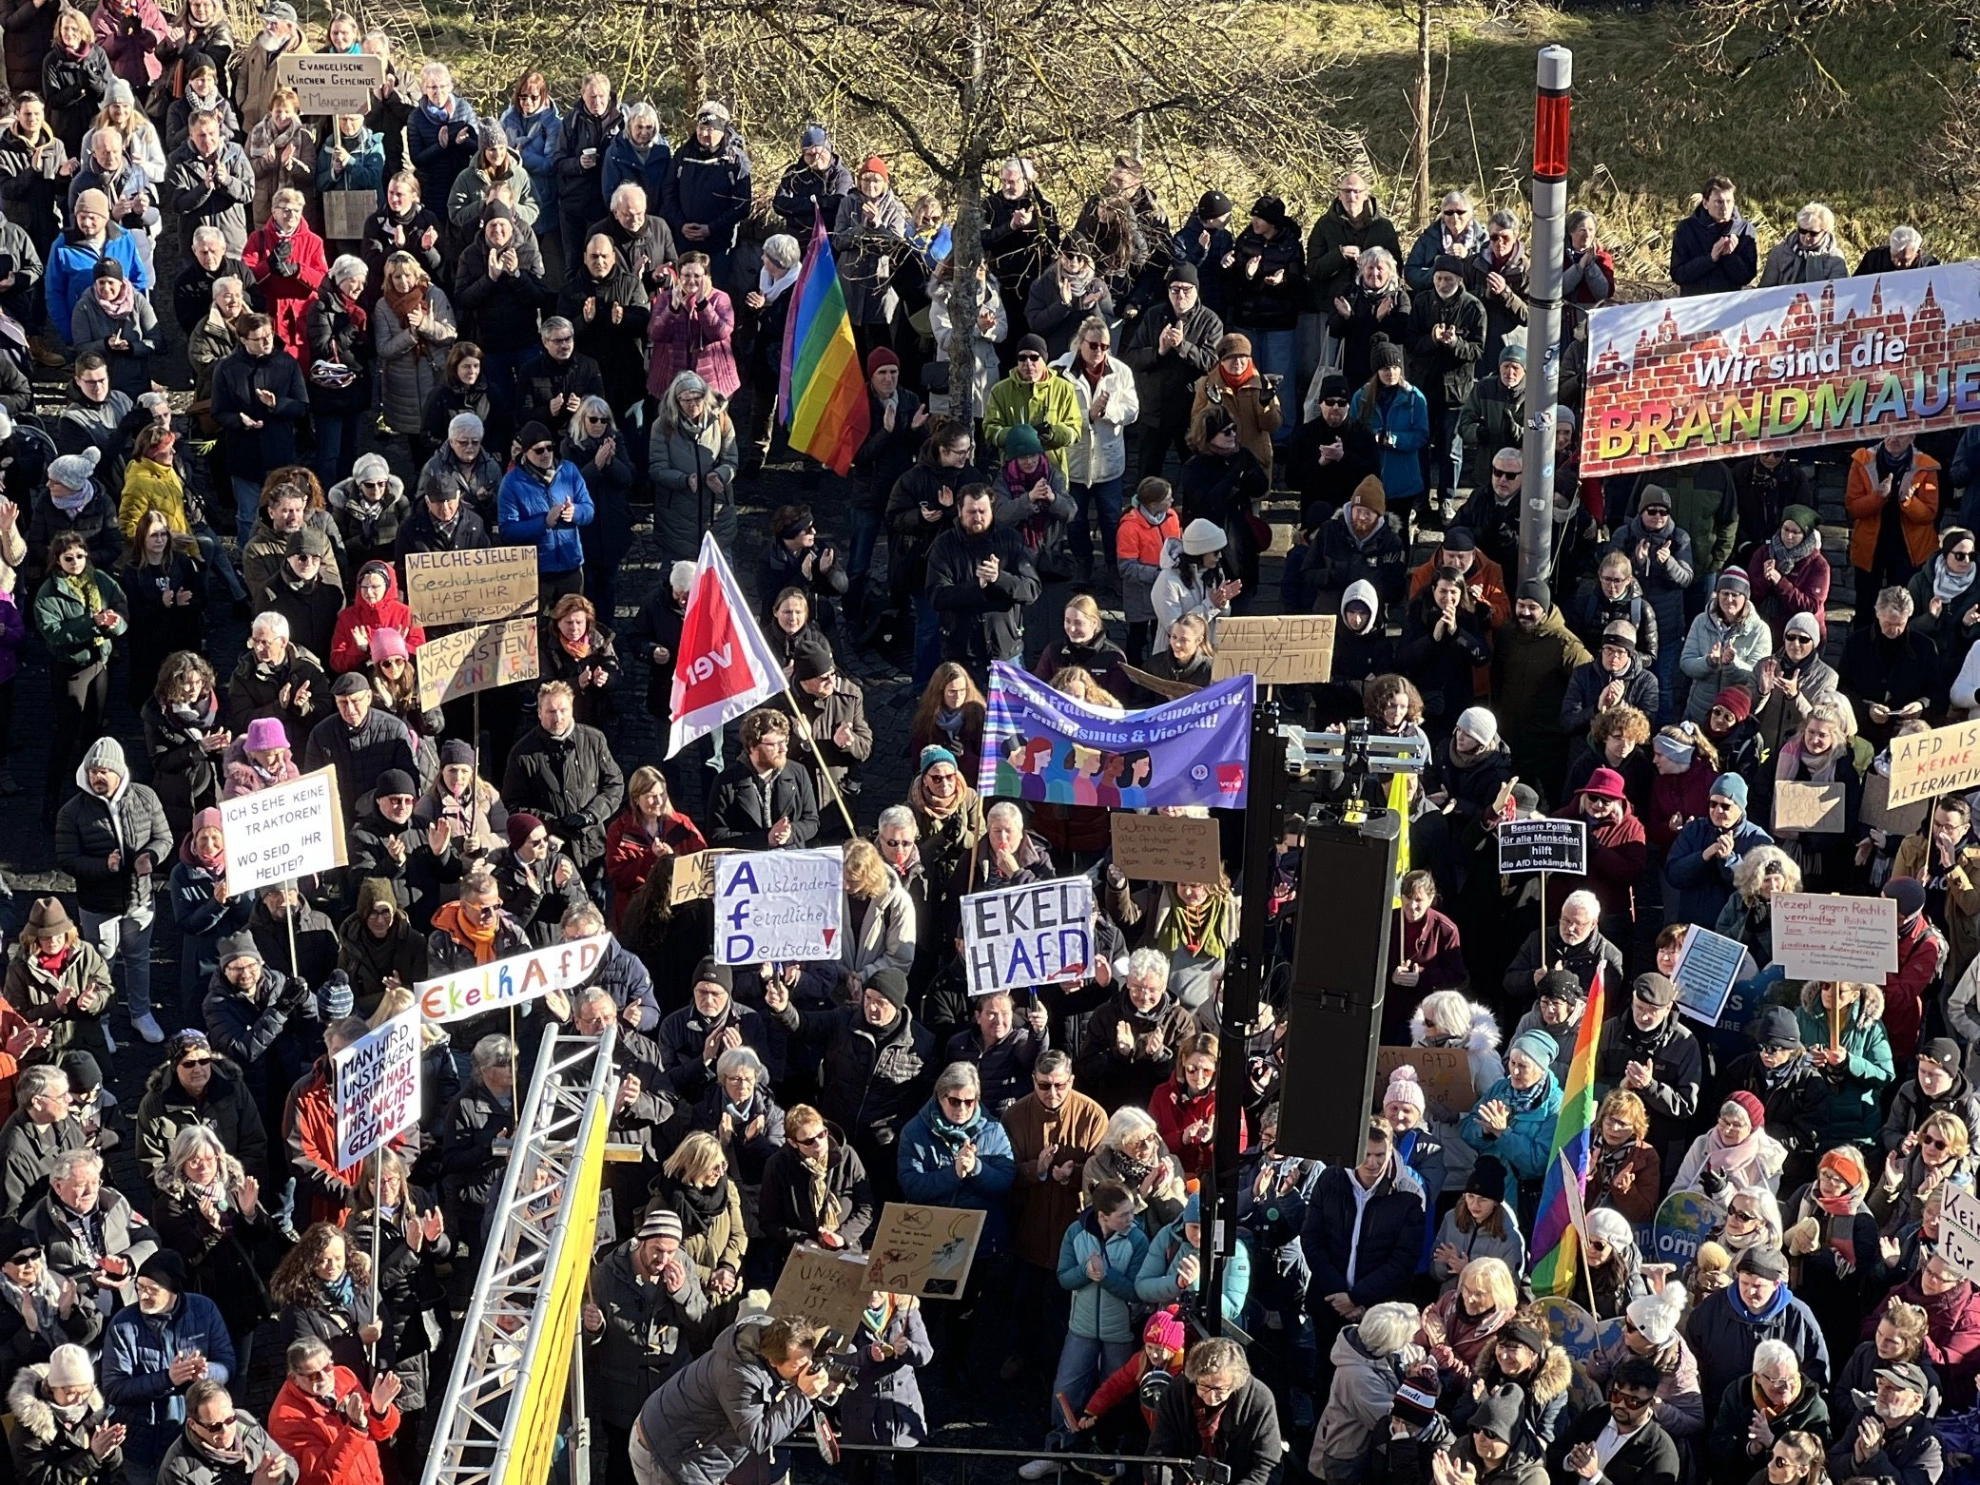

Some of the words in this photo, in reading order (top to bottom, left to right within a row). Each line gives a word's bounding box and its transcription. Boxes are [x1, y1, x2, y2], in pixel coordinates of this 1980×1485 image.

[287, 74, 326, 85] KIRCHEN
[331, 74, 376, 86] GEMEINDE
[299, 60, 363, 71] EVANGELISCHE
[1695, 355, 1760, 388] Wir
[1768, 339, 1841, 380] sind
[1851, 332, 1906, 367] die
[1599, 364, 1980, 460] BRANDMAUE
[408, 552, 471, 569] WELCHE
[473, 548, 518, 564] STELLE
[521, 548, 536, 560] IM
[432, 590, 470, 604] HABT
[480, 585, 508, 599] IHR
[413, 609, 456, 622] NICHT
[1221, 621, 1256, 643] NIE
[1262, 618, 1333, 641] WIEDER
[419, 638, 450, 660] WER
[452, 629, 490, 647] SIND
[495, 620, 524, 635] DIE
[1263, 642, 1287, 655] IST
[1021, 706, 1128, 743] Feminismus
[1131, 730, 1145, 743] &
[1901, 737, 1942, 761] AFD
[1917, 750, 1973, 775] KEINE
[1891, 768, 1980, 802] ALTERNATIV
[226, 807, 247, 822] ICH
[251, 795, 285, 814] SEHE
[293, 785, 325, 802] KEINE
[245, 804, 321, 836] TRAKTOREN!
[1511, 823, 1544, 832] Bessere
[1546, 822, 1572, 831] Politik
[237, 852, 258, 867] WO
[263, 843, 290, 860] SEID
[301, 831, 322, 846] IHR
[1501, 836, 1514, 844] für
[1516, 835, 1532, 843] alle
[1534, 834, 1580, 844] Menschen
[1532, 846, 1552, 855] hilft
[1501, 860, 1514, 868] die
[1516, 859, 1531, 867] AfD
[975, 884, 1086, 939] EKEL
[1774, 895, 1812, 912] Rezept
[1819, 903, 1848, 914] gegen
[342, 1044, 373, 1080] MAN
[376, 1024, 408, 1057] WIRD
[344, 1067, 371, 1099] UNS
[372, 1037, 414, 1080] FRAGEN
[343, 1079, 384, 1120] WARUM
[386, 1056, 414, 1088] HABT
[344, 1110, 368, 1139] IHR
[372, 1075, 415, 1122] NICHTS
[348, 1103, 406, 1156] GETAN?
[1945, 1231, 1975, 1270] für
